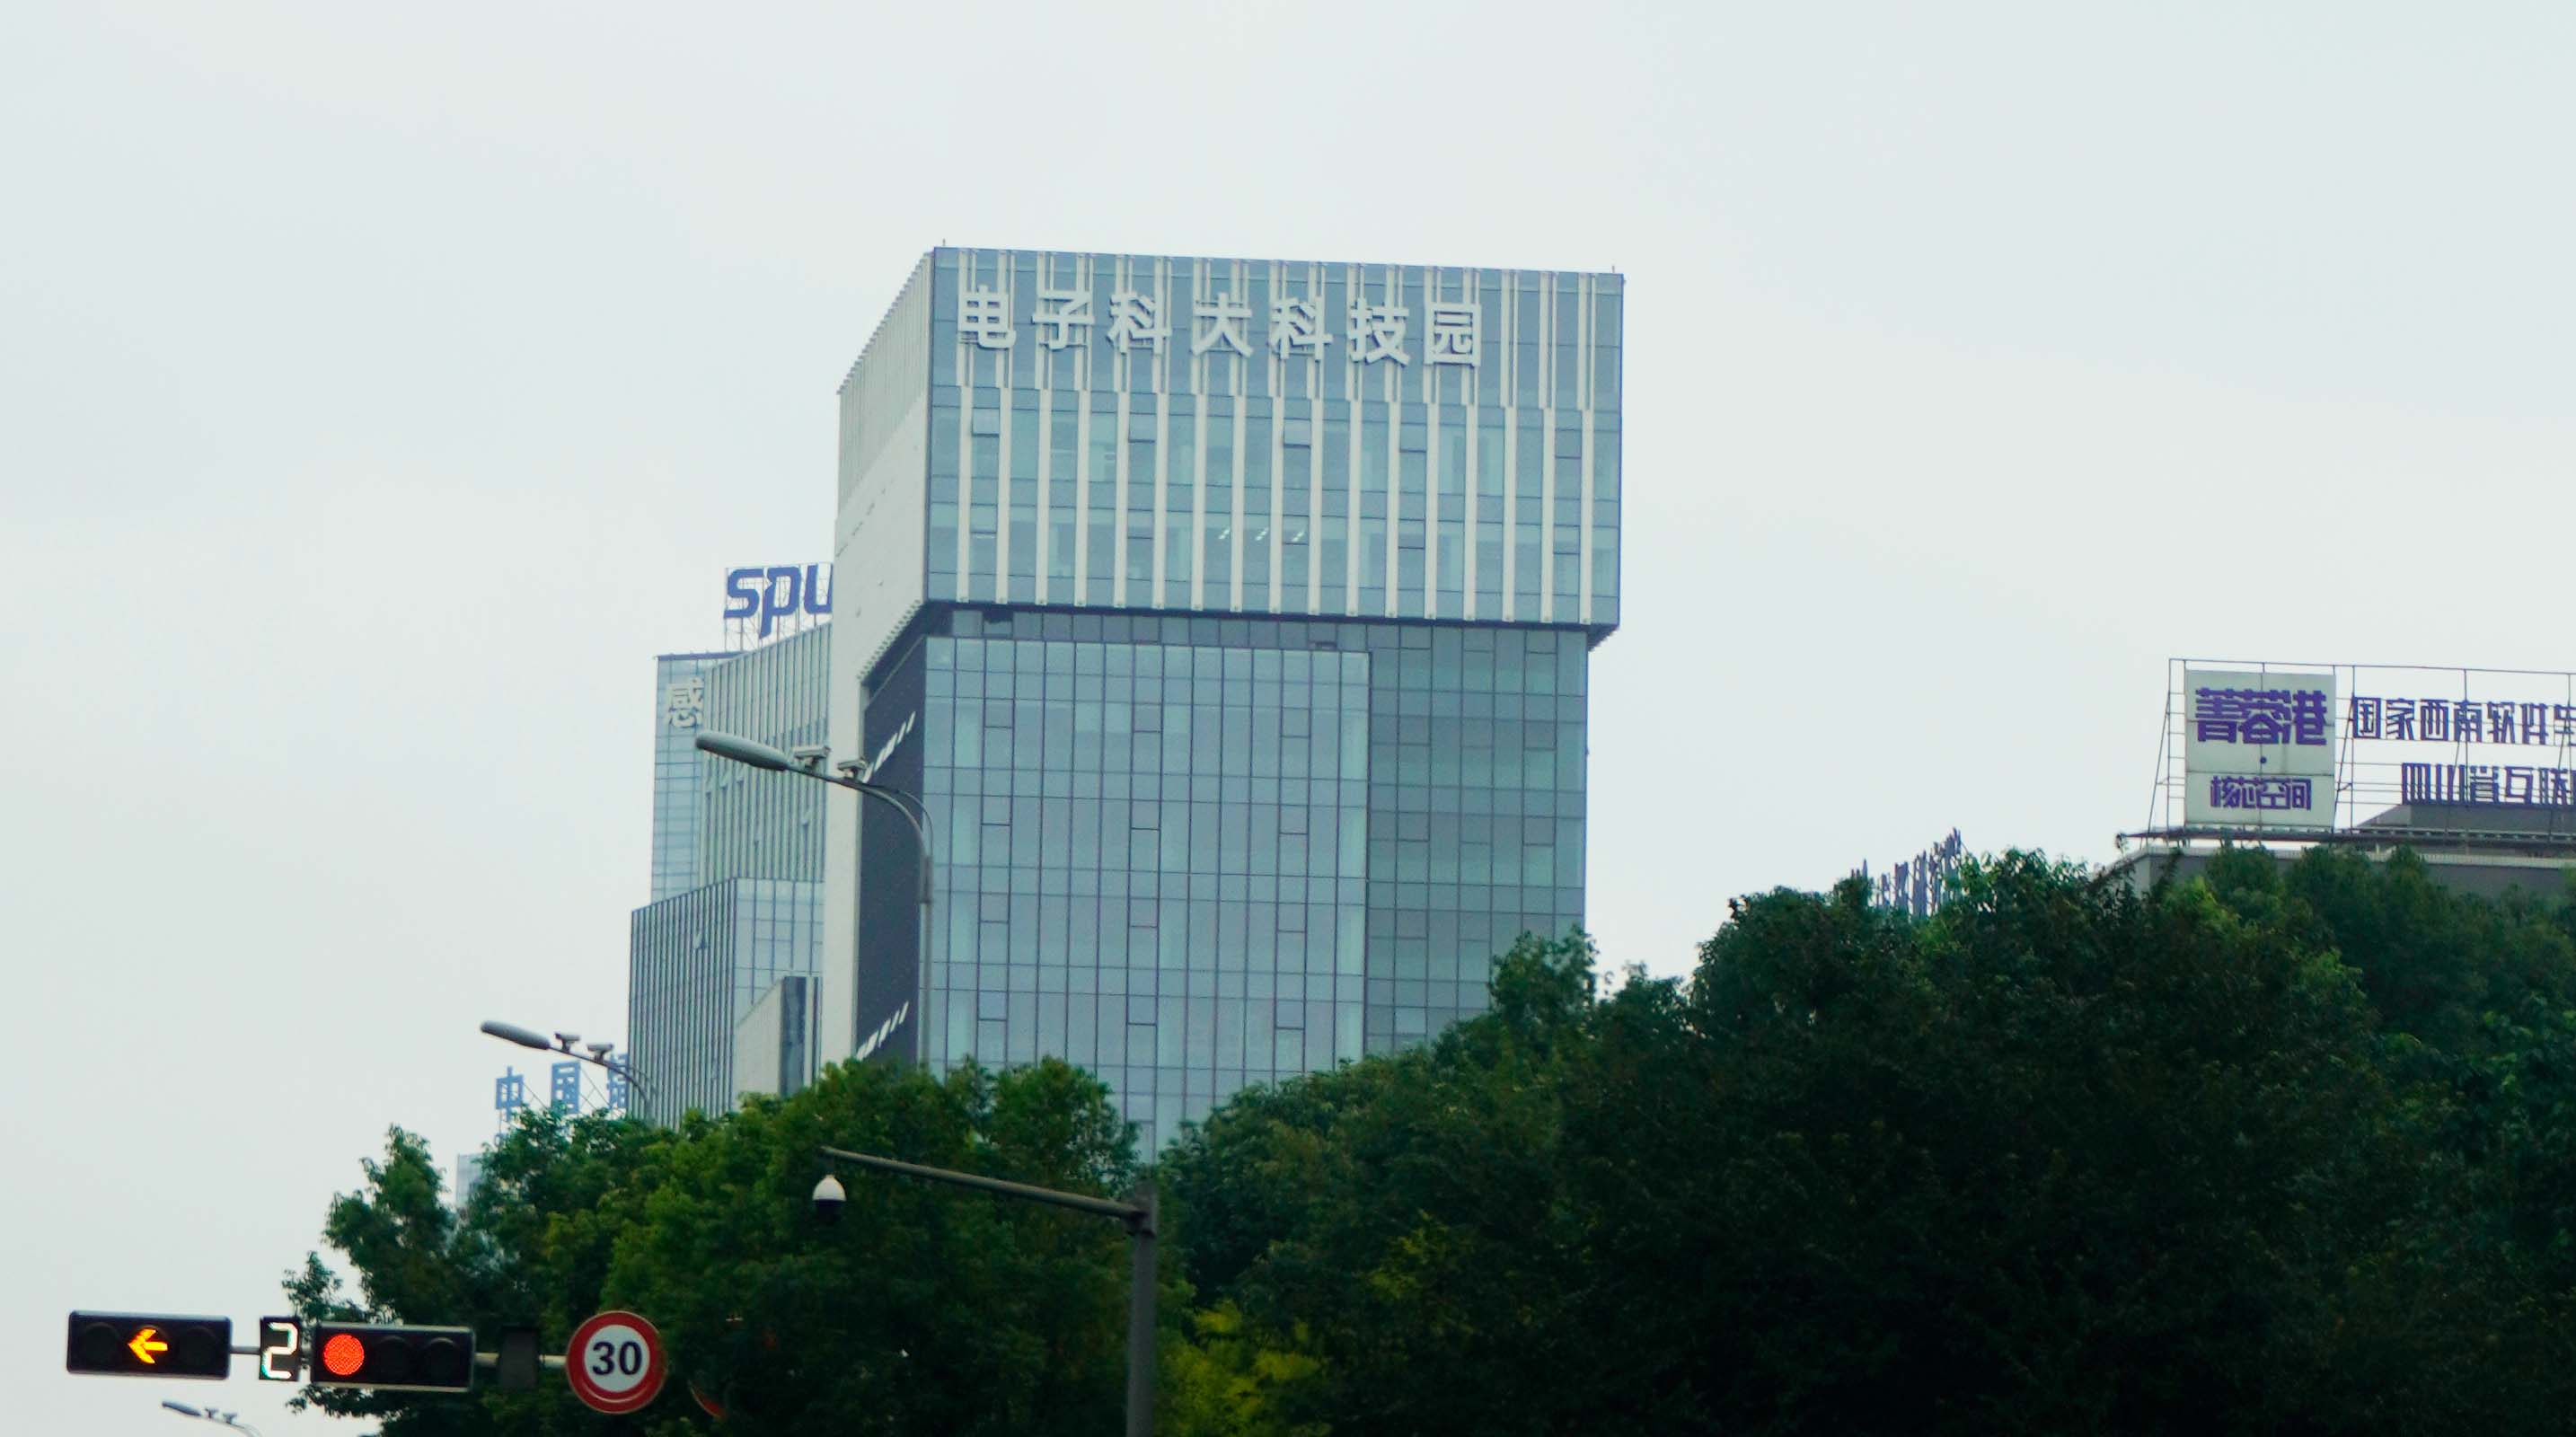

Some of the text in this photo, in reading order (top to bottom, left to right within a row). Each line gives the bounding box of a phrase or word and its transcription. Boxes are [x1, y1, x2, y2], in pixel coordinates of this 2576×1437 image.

[957, 285, 1482, 367] 电子科大科技园
[2401, 763, 2576, 805] 四川省互联
[261, 1322, 298, 1379] 2
[592, 1341, 642, 1376] 30
